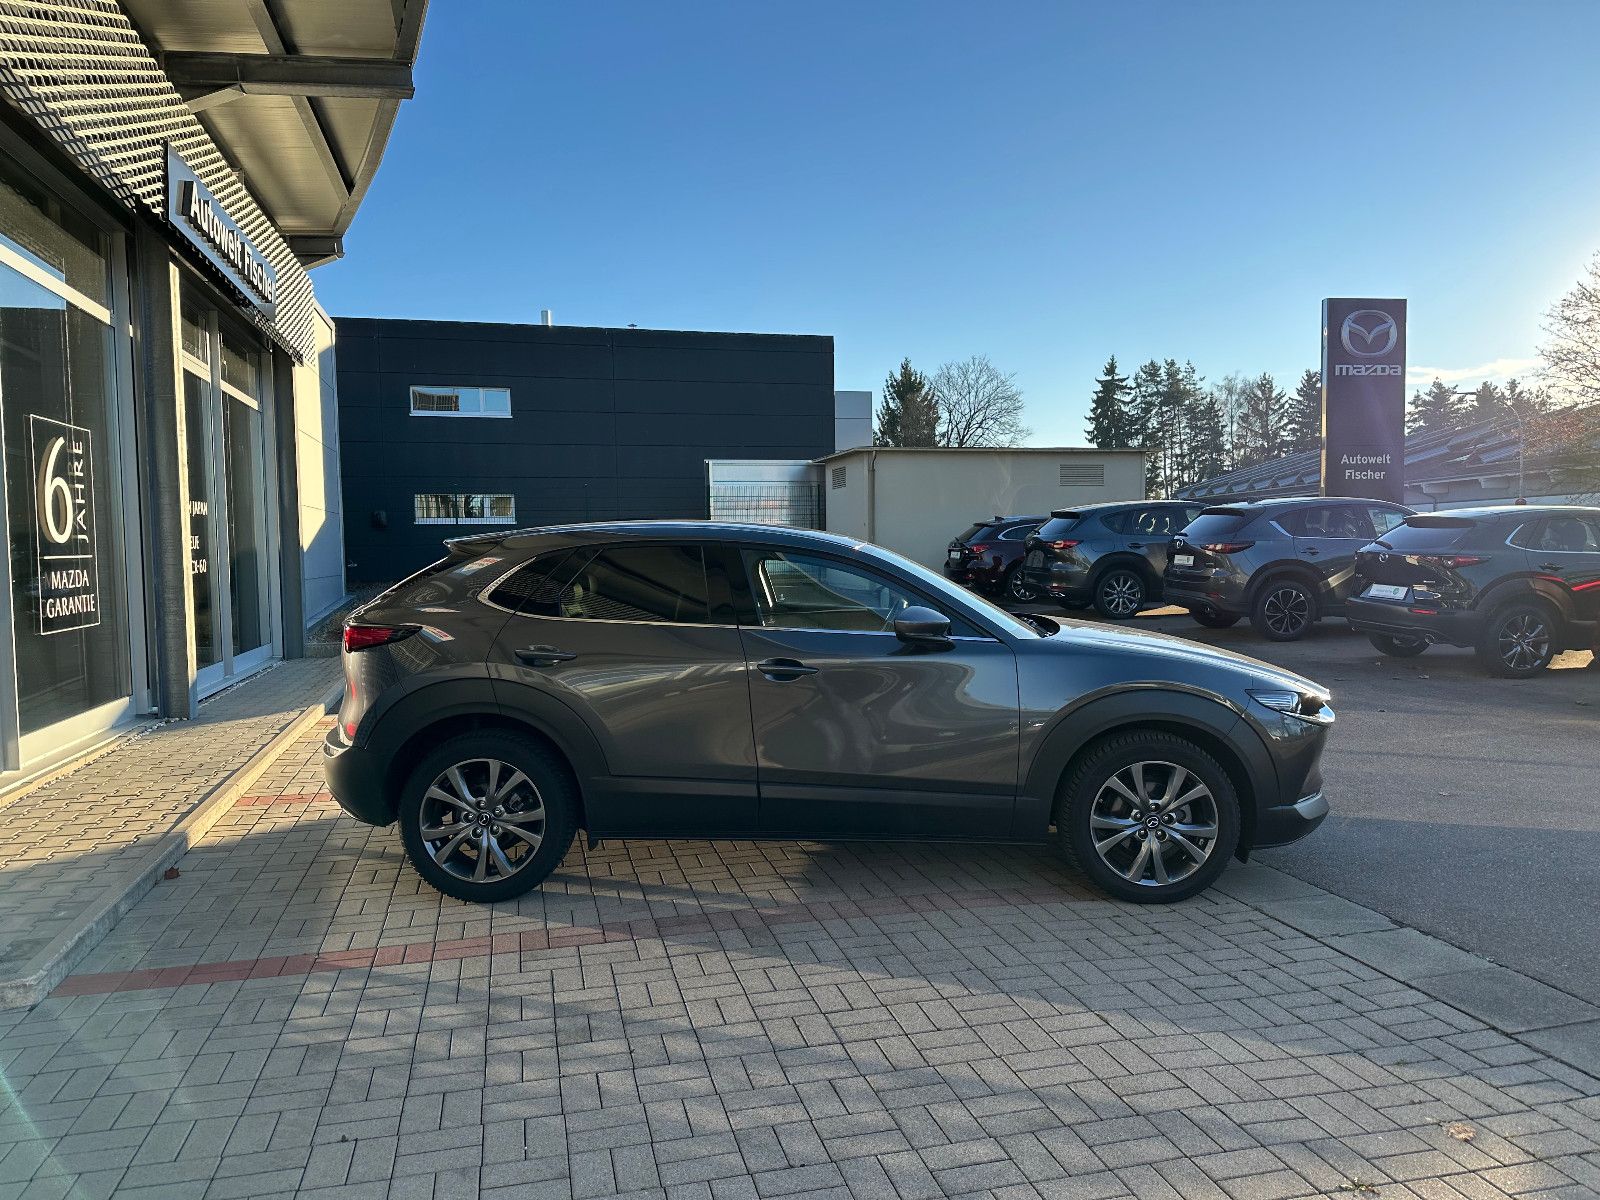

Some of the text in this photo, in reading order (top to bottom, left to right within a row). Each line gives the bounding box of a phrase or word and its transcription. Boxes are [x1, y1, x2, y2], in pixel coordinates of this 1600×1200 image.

[190, 180, 242, 269] Autowelt
[1341, 454, 1391, 464] Autowelt
[1345, 469, 1386, 480] Fischer
[45, 436, 73, 544] 6
[73, 440, 89, 543] JAHRE
[51, 569, 89, 589] MAZDA
[47, 593, 95, 618] GARANTIE
